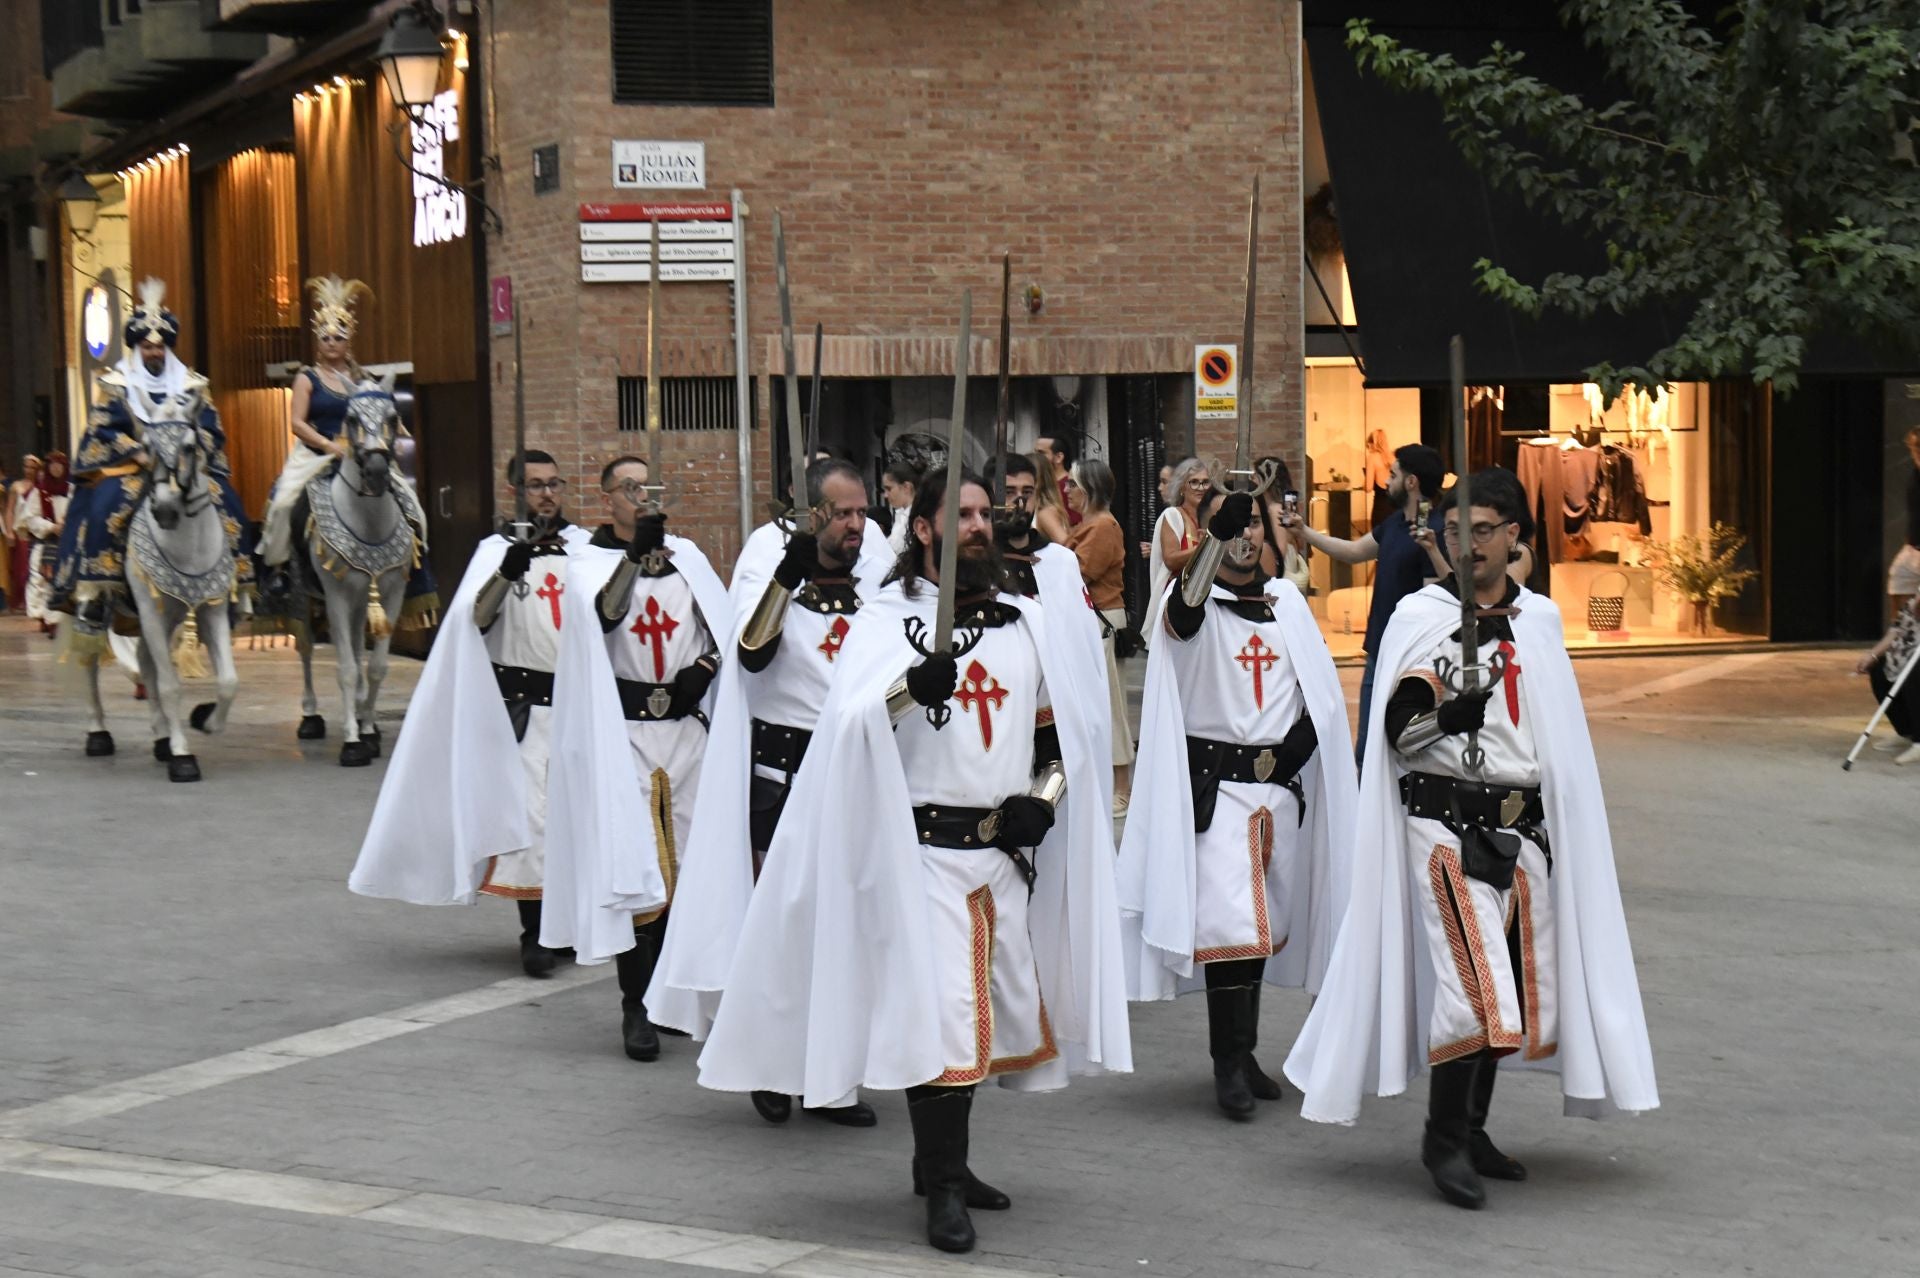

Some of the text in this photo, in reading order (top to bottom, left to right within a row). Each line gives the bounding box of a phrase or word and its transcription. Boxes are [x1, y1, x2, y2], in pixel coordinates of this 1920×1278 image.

[641, 152, 697, 168] JULIÁN
[641, 169, 699, 183] ROMEA
[414, 189, 466, 247] ARCO
[642, 205, 726, 216] turismodemurcia.es
